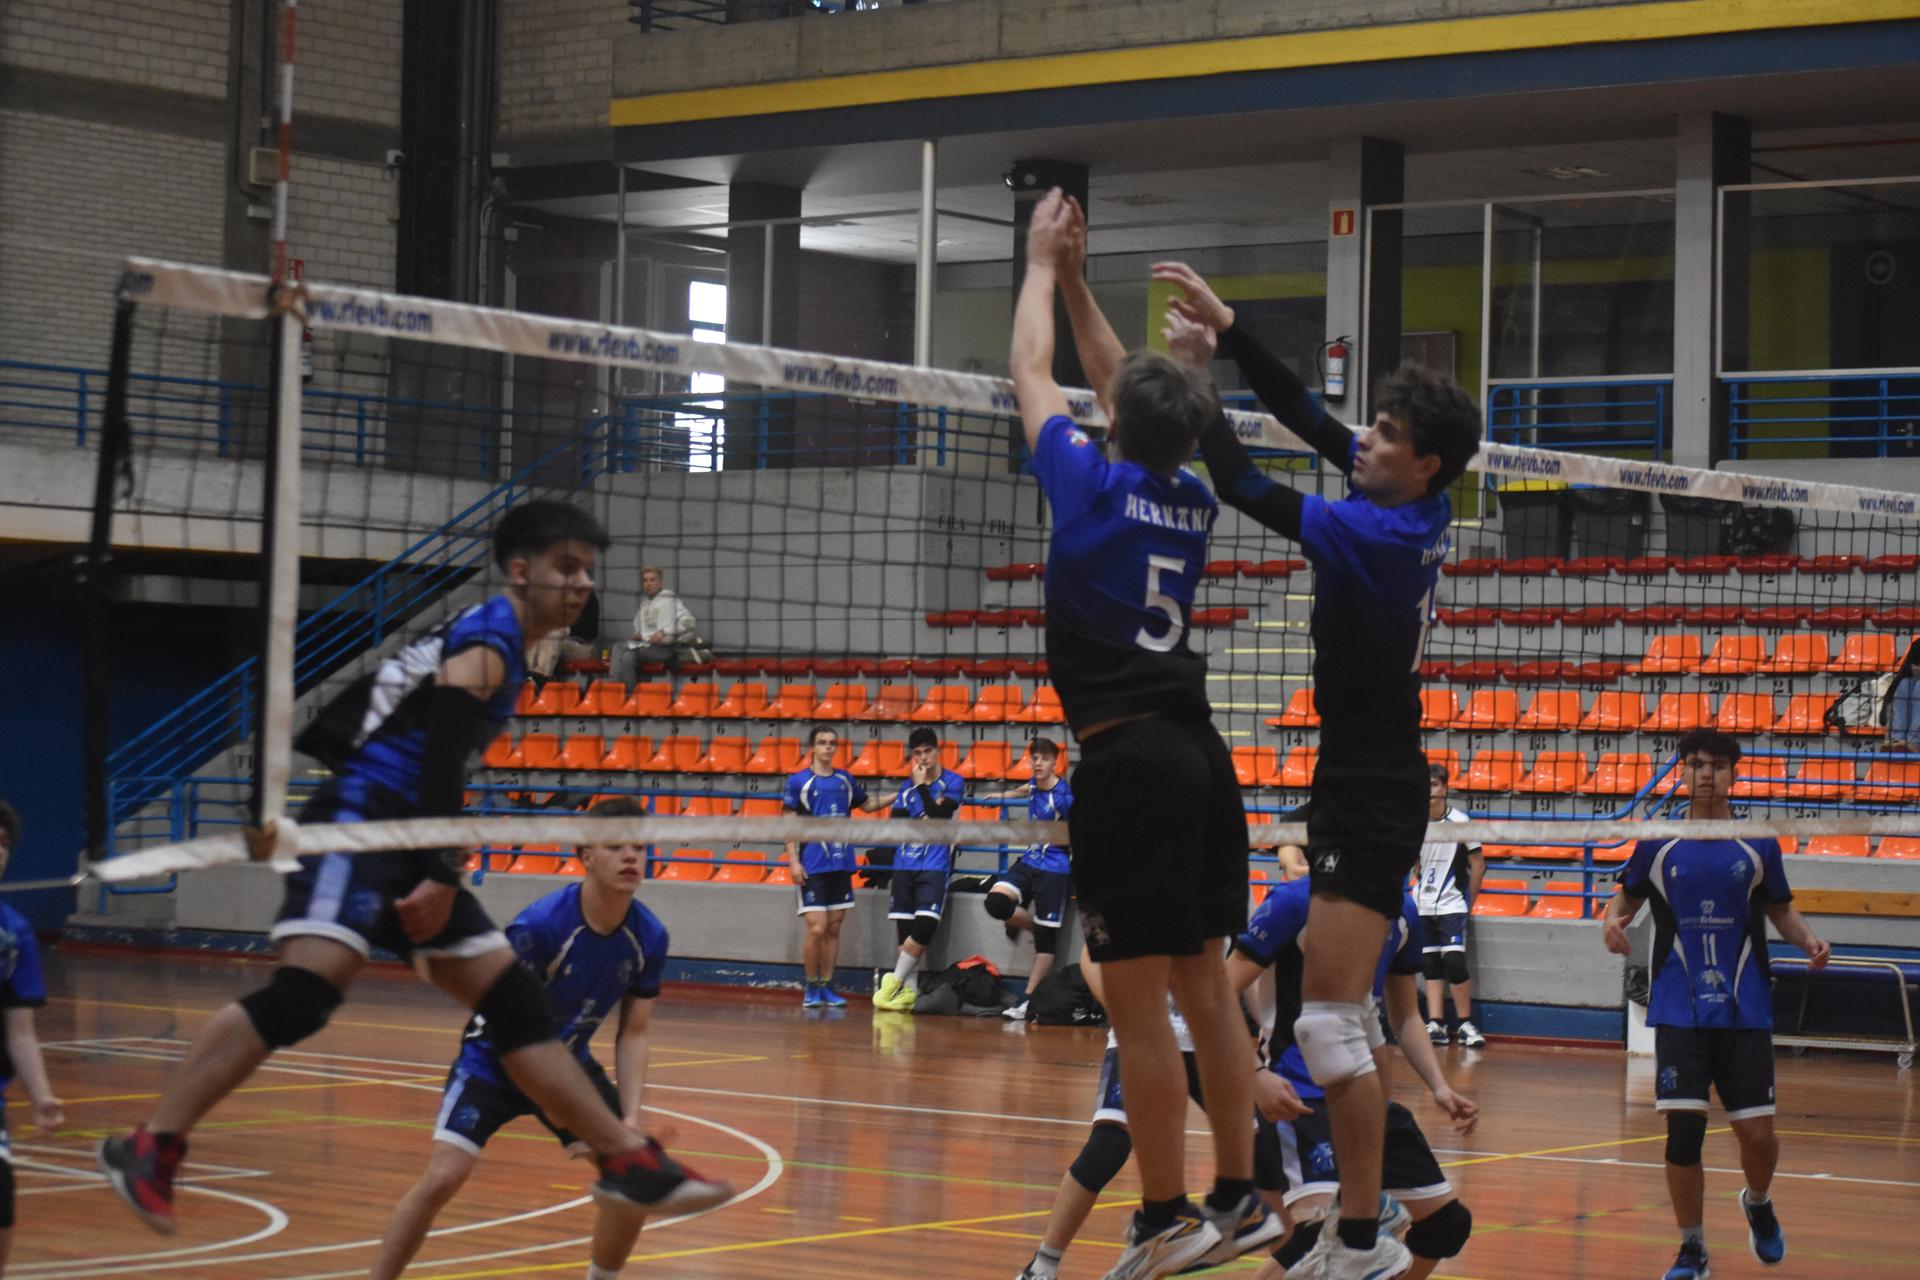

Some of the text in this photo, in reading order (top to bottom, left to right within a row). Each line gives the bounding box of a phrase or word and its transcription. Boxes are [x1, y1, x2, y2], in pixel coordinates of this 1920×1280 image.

[783, 361, 899, 395] www.rfevb.com
[1487, 451, 1561, 476] www.rfevb.com
[1619, 467, 1689, 491] www.rfevb.com
[1742, 482, 1809, 503] www.rfevb.com
[1135, 554, 1187, 653] 5
[1708, 679, 1730, 694] 20
[1774, 679, 1794, 693] 21
[1530, 735, 1546, 750] 18
[1593, 735, 1610, 751] 19
[1702, 933, 1718, 966] 11
